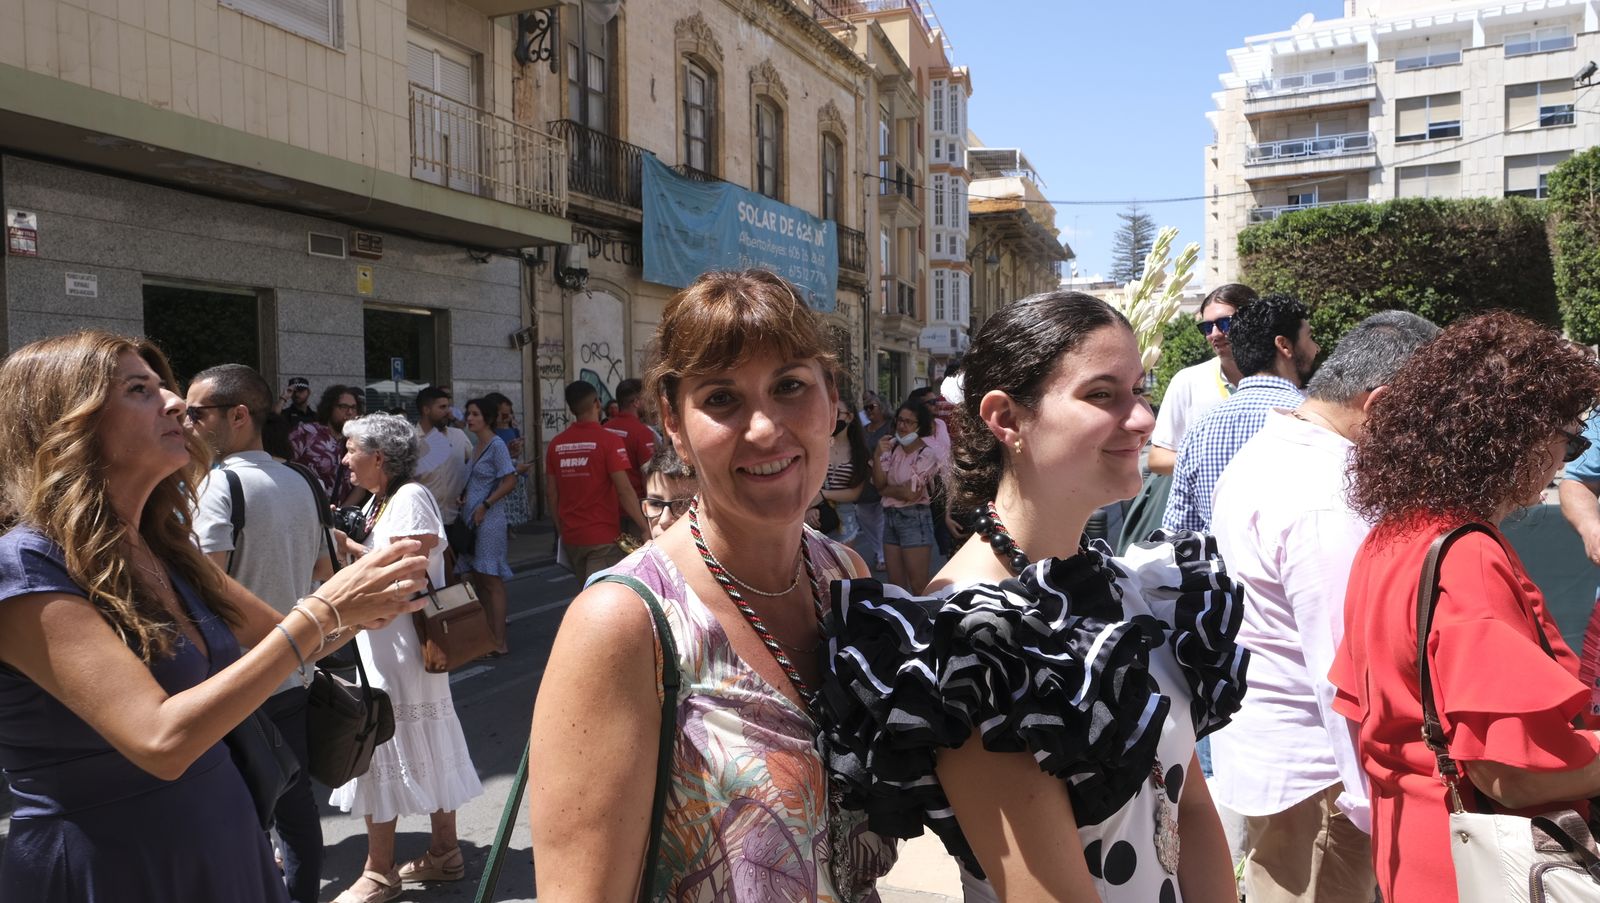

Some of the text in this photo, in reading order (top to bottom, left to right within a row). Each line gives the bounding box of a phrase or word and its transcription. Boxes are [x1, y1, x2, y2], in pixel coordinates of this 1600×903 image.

[738, 201, 776, 232] SOLAR
[780, 215, 794, 237] DE
[560, 457, 588, 468] MRW
